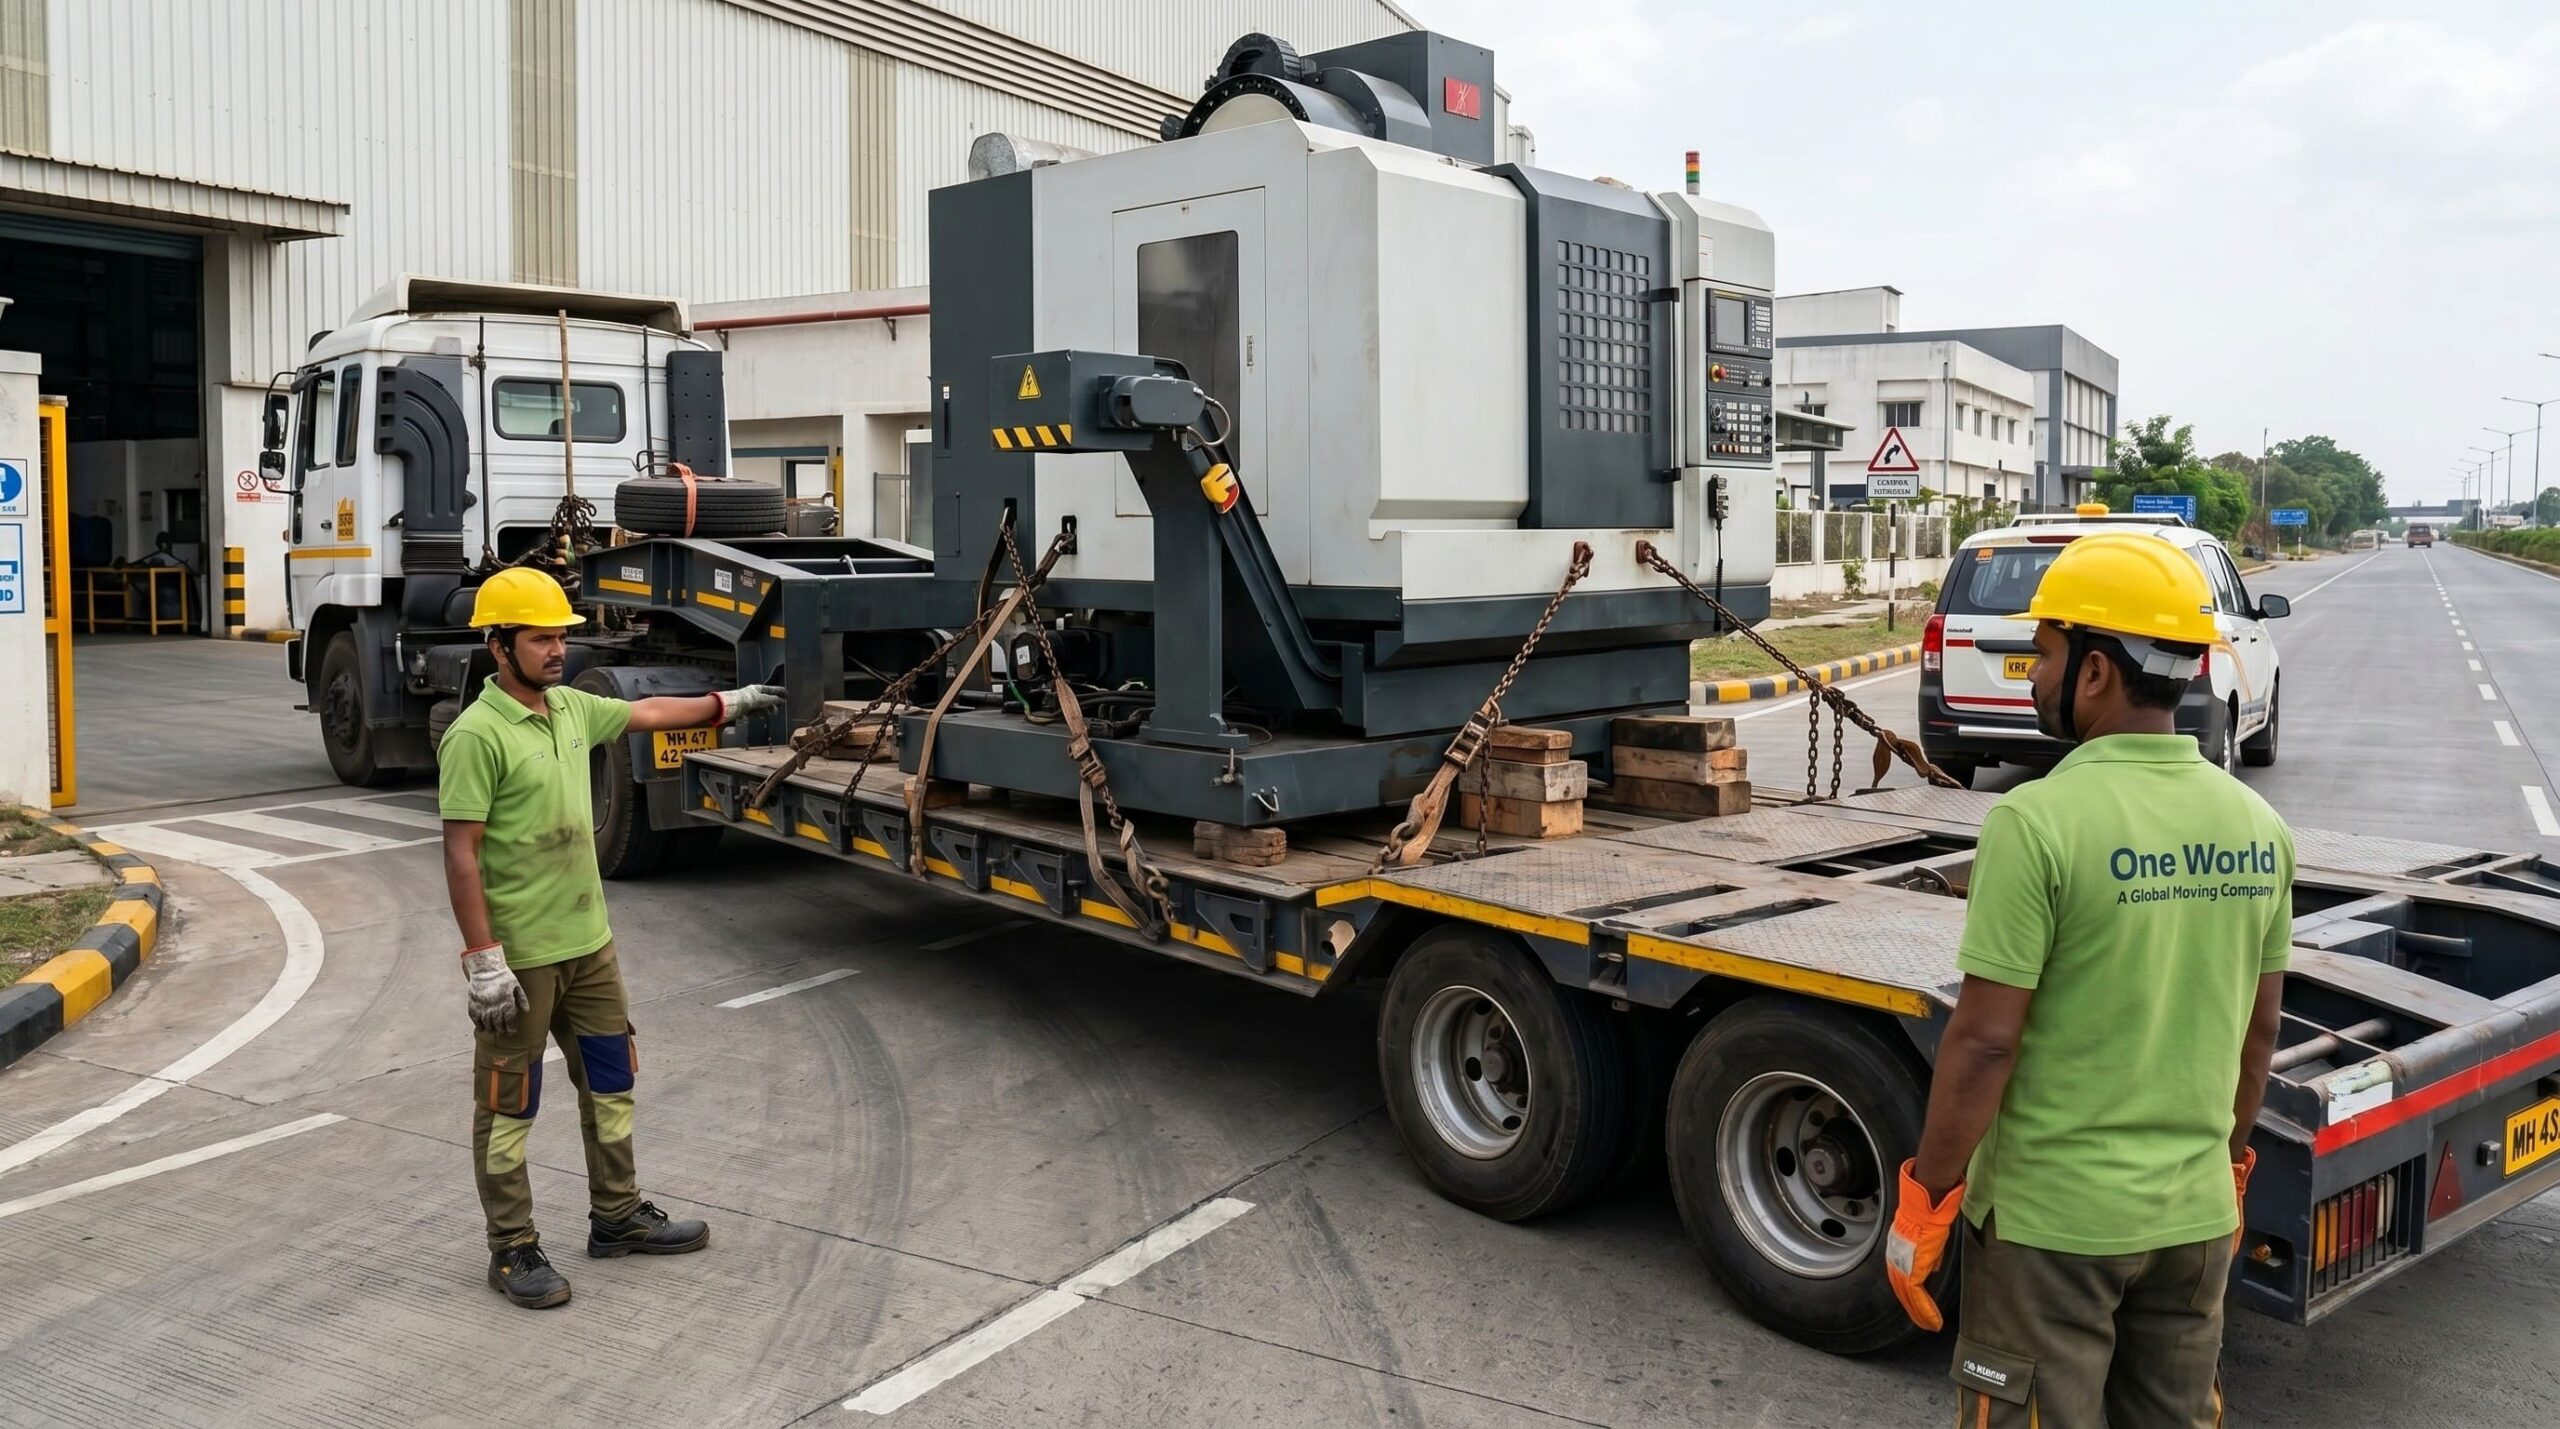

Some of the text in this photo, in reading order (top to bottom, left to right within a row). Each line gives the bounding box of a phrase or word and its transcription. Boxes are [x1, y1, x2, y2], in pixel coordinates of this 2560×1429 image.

[691, 730, 708, 745] 47
[2110, 841, 2276, 882] One World
[2117, 883, 2276, 905] A Global Moving Company
[2512, 1118, 2537, 1163] MH
